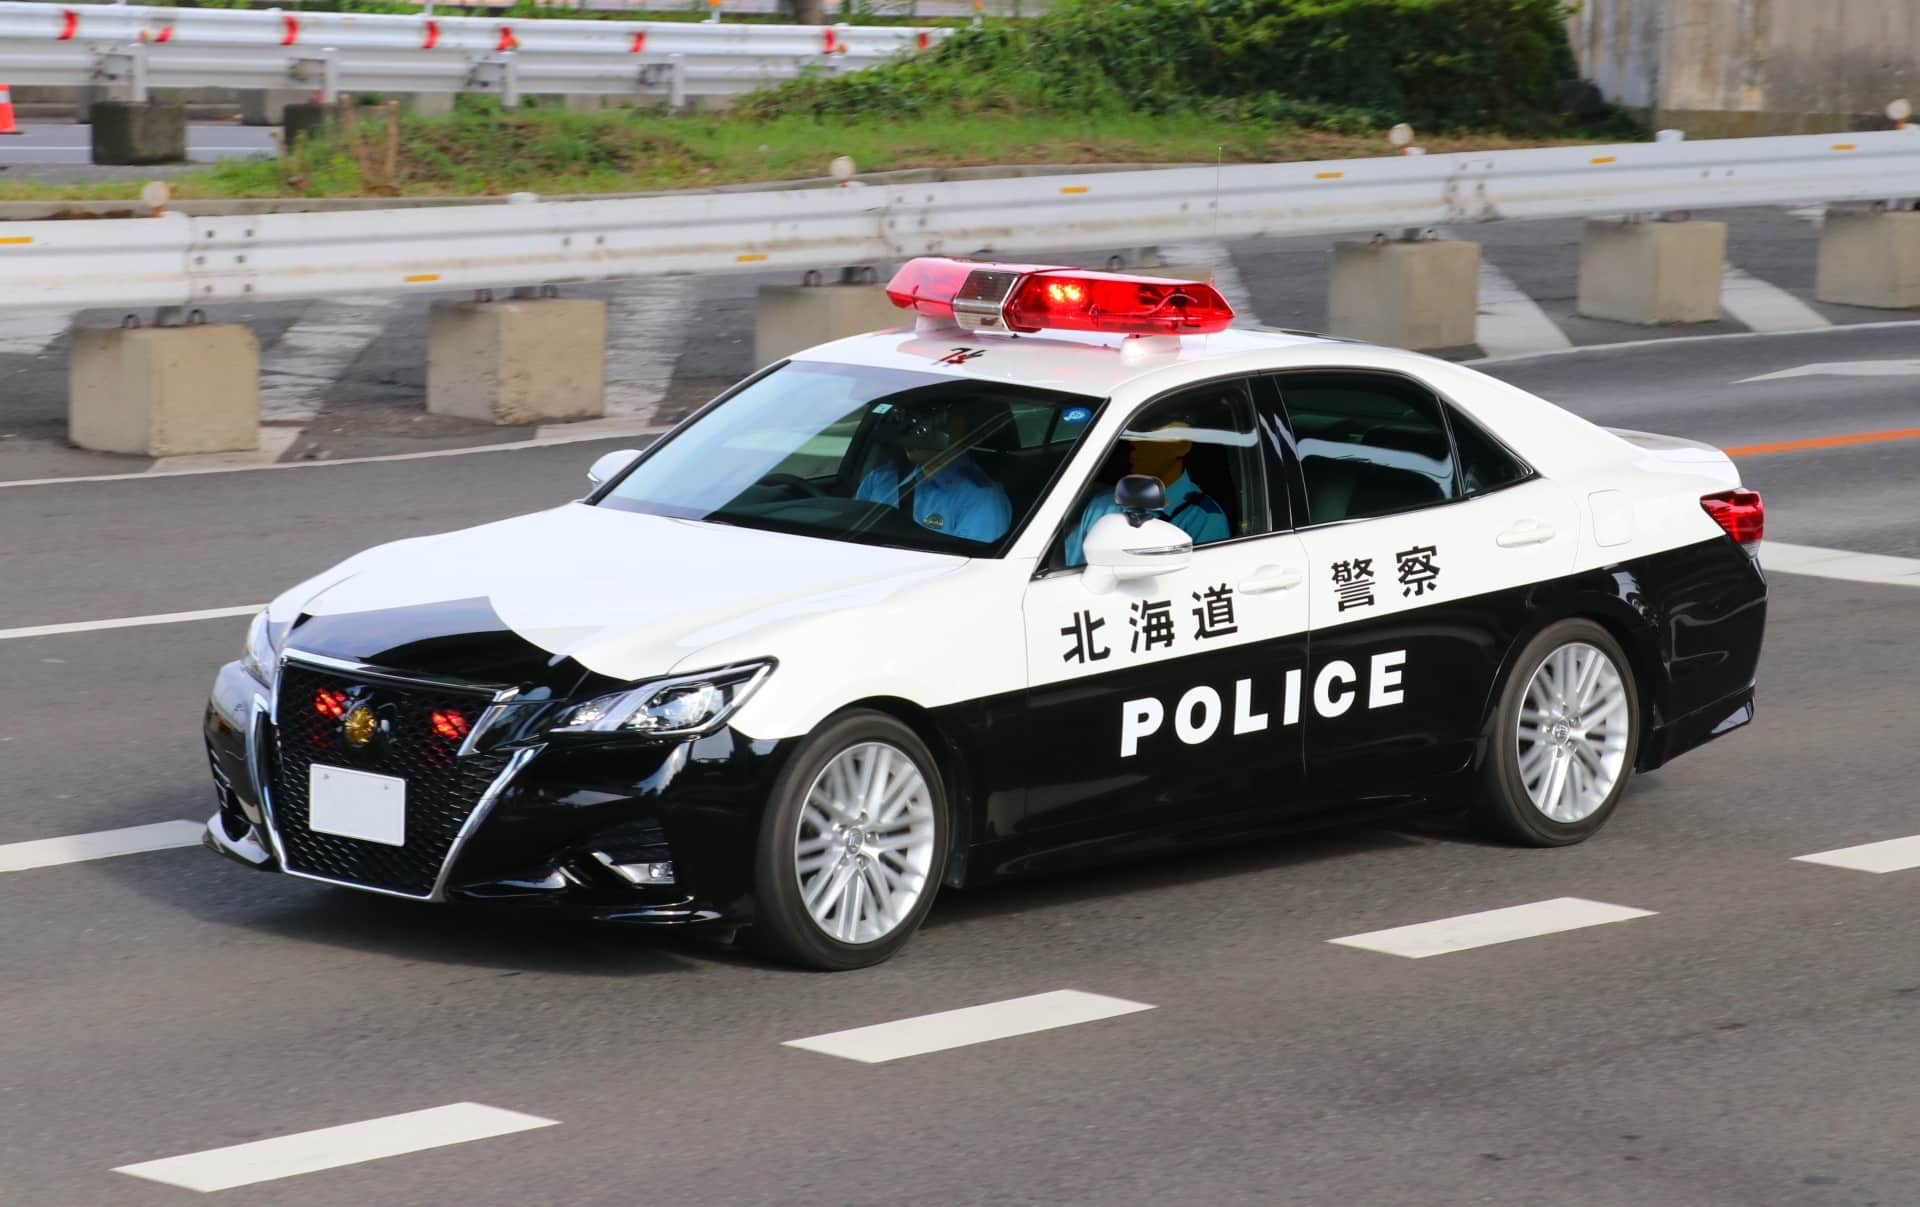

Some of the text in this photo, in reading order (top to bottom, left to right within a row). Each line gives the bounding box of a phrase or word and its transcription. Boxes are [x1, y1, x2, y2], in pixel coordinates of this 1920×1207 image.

[1060, 545, 1441, 664] 北海道 警察
[1120, 649, 1407, 758] POLICE
